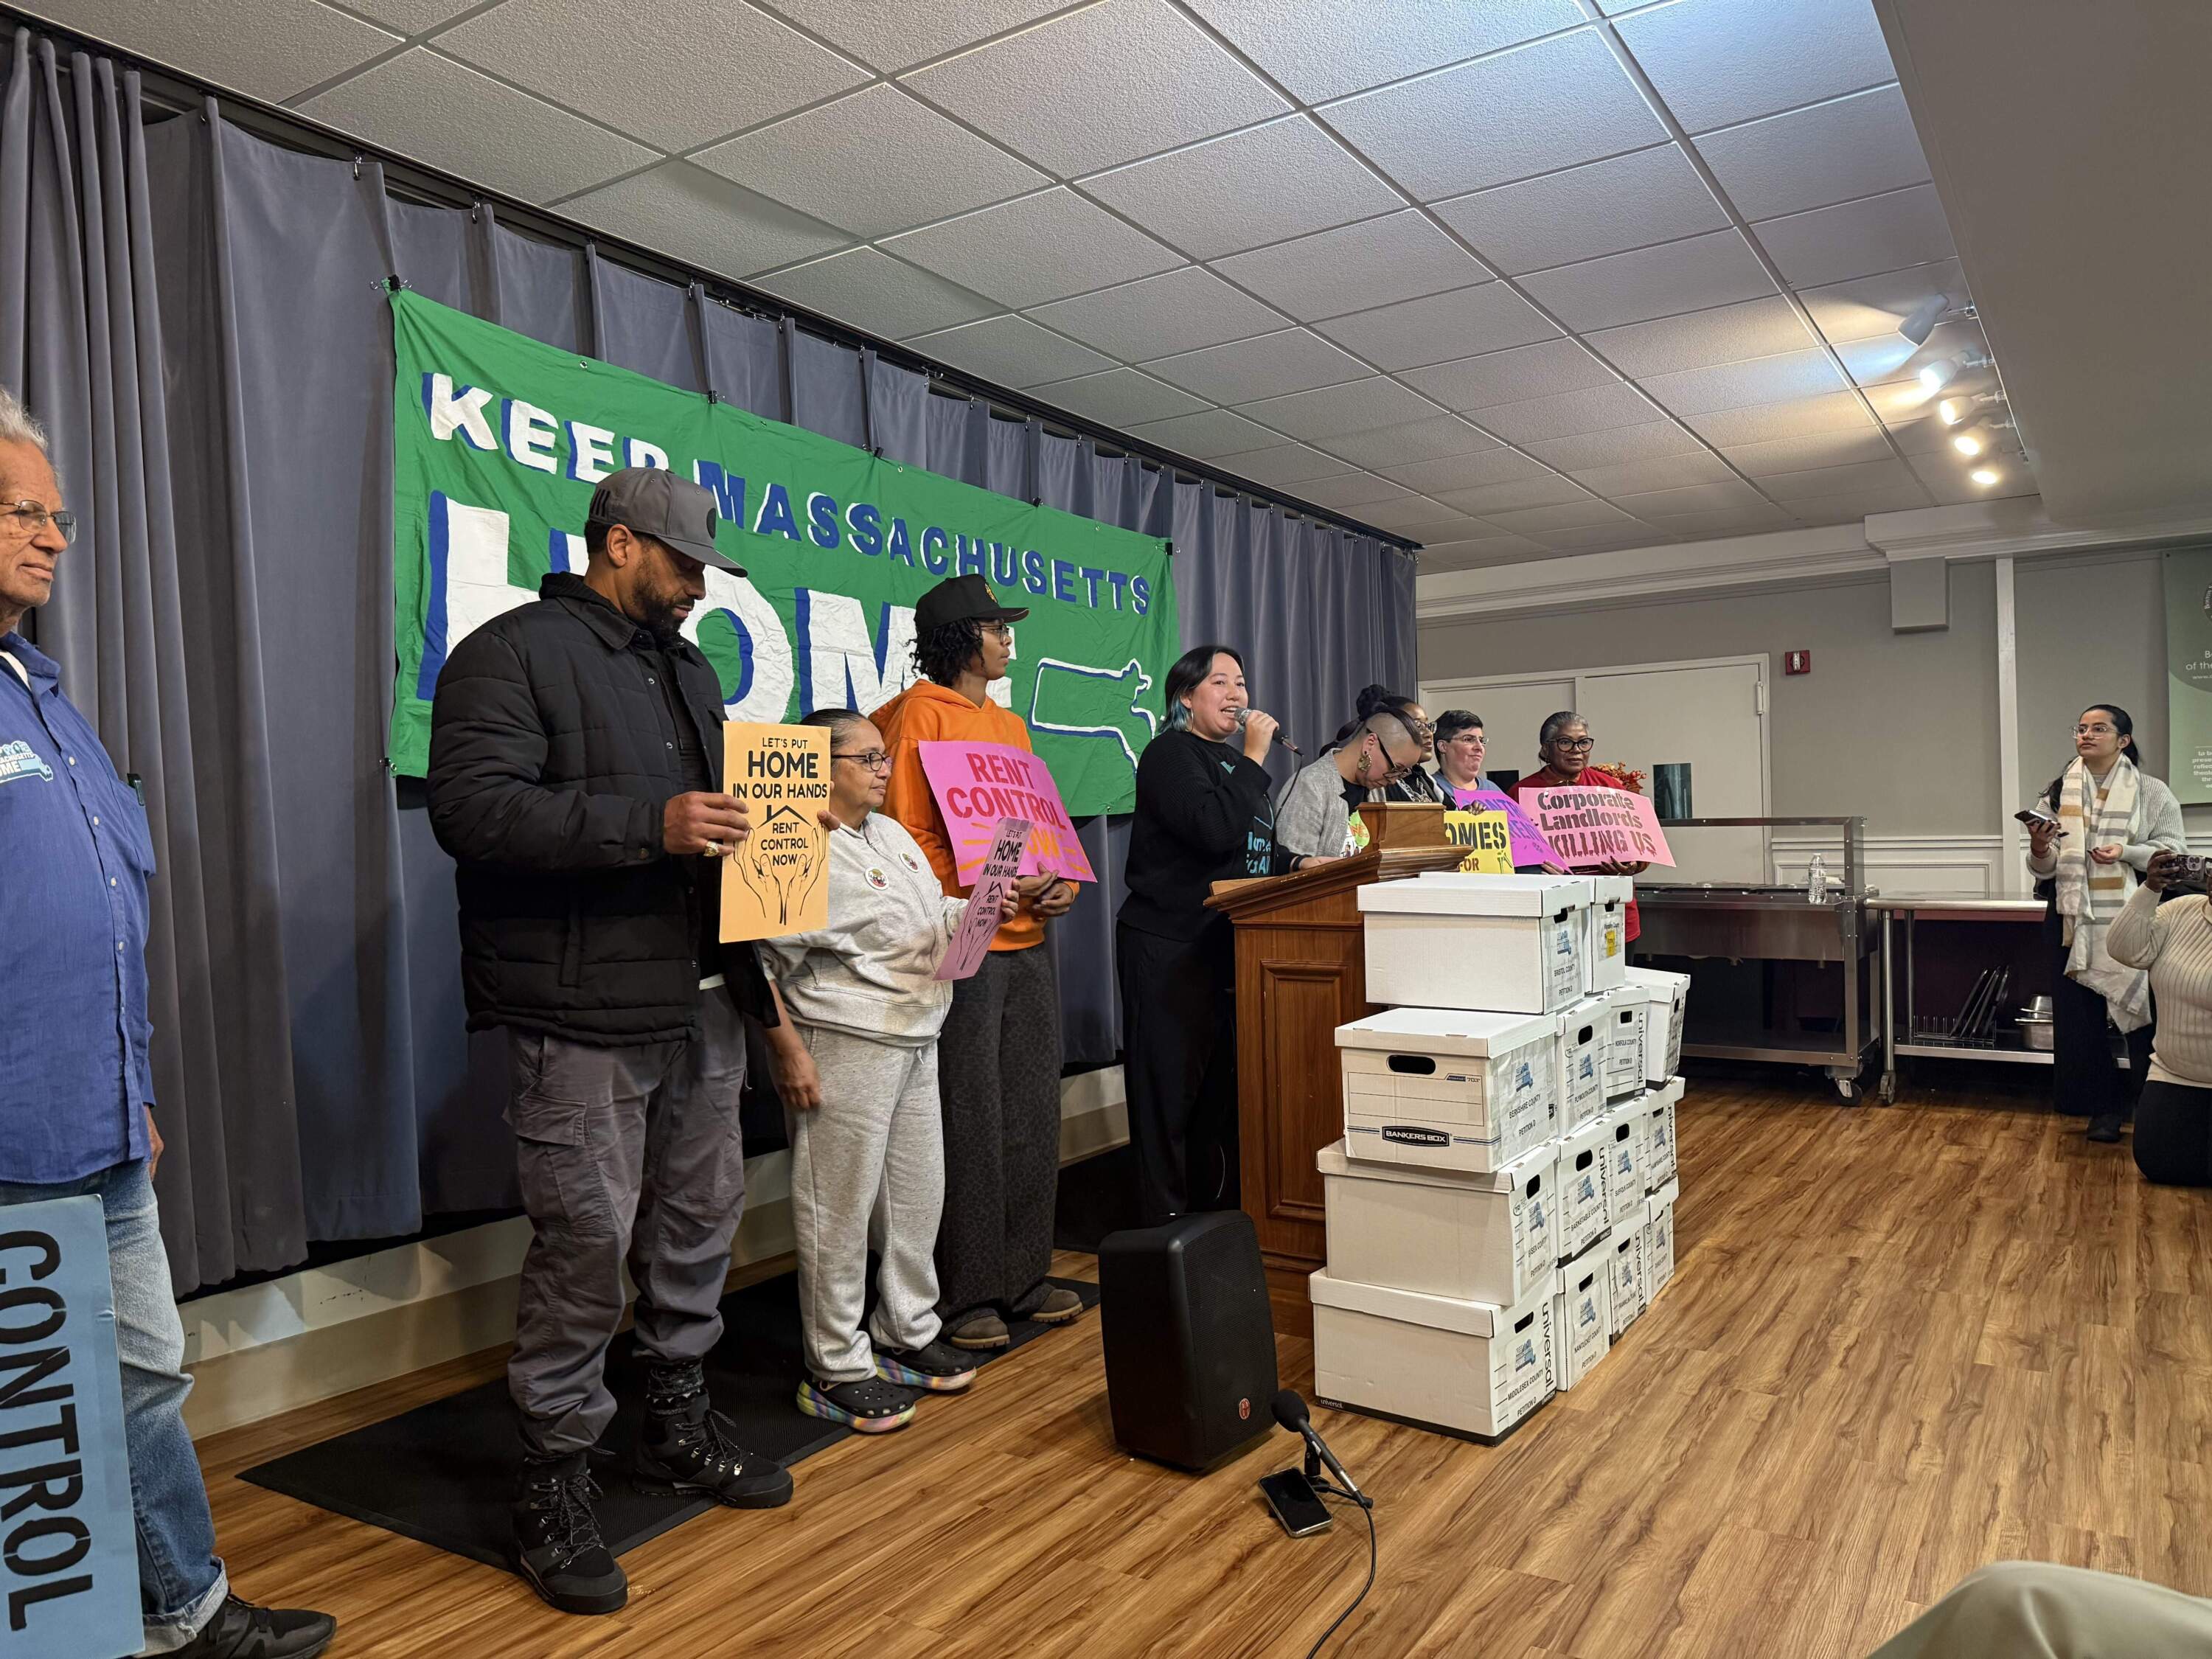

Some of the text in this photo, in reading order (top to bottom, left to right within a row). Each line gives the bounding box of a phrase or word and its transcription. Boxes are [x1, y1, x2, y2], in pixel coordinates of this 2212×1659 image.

[693, 459, 1151, 616] MASSACHUSETTS
[2185, 661, 2197, 671] of
[762, 737, 808, 749] LET'S PUT
[748, 751, 818, 779] HOME
[966, 753, 1035, 790] RENT
[733, 783, 827, 799] IN OUR HANDS
[1537, 791, 1635, 811] Corporate
[946, 787, 1067, 830] CONTROL
[772, 822, 800, 834] RENT
[1540, 808, 1644, 832] Landlords
[760, 838, 809, 850] CONTROL
[994, 839, 1023, 863] HOME
[1630, 831, 1657, 857] US
[773, 854, 798, 866] NOW
[983, 863, 991, 875] IN
[990, 865, 1002, 877] OUR
[1460, 858, 1480, 871] OR
[986, 894, 999, 903] RENT
[977, 906, 997, 916] CONTROL
[1509, 1093, 1541, 1119] BERKSHIRE COUNTY
[1385, 1130, 1447, 1143] BANKERS BOX
[1571, 1211, 1591, 1231] BARNSTABLE
[1635, 1230, 1644, 1305] universal
[1542, 1302, 1554, 1385] universal
[1574, 1336, 1592, 1354] NANTUCKET
[1508, 1380, 1529, 1401] MIDDLESEX
[1529, 1368, 1544, 1386] COUNTY
[1517, 1400, 1534, 1417] PETITION
[0, 1230, 93, 1631] CONTROL
